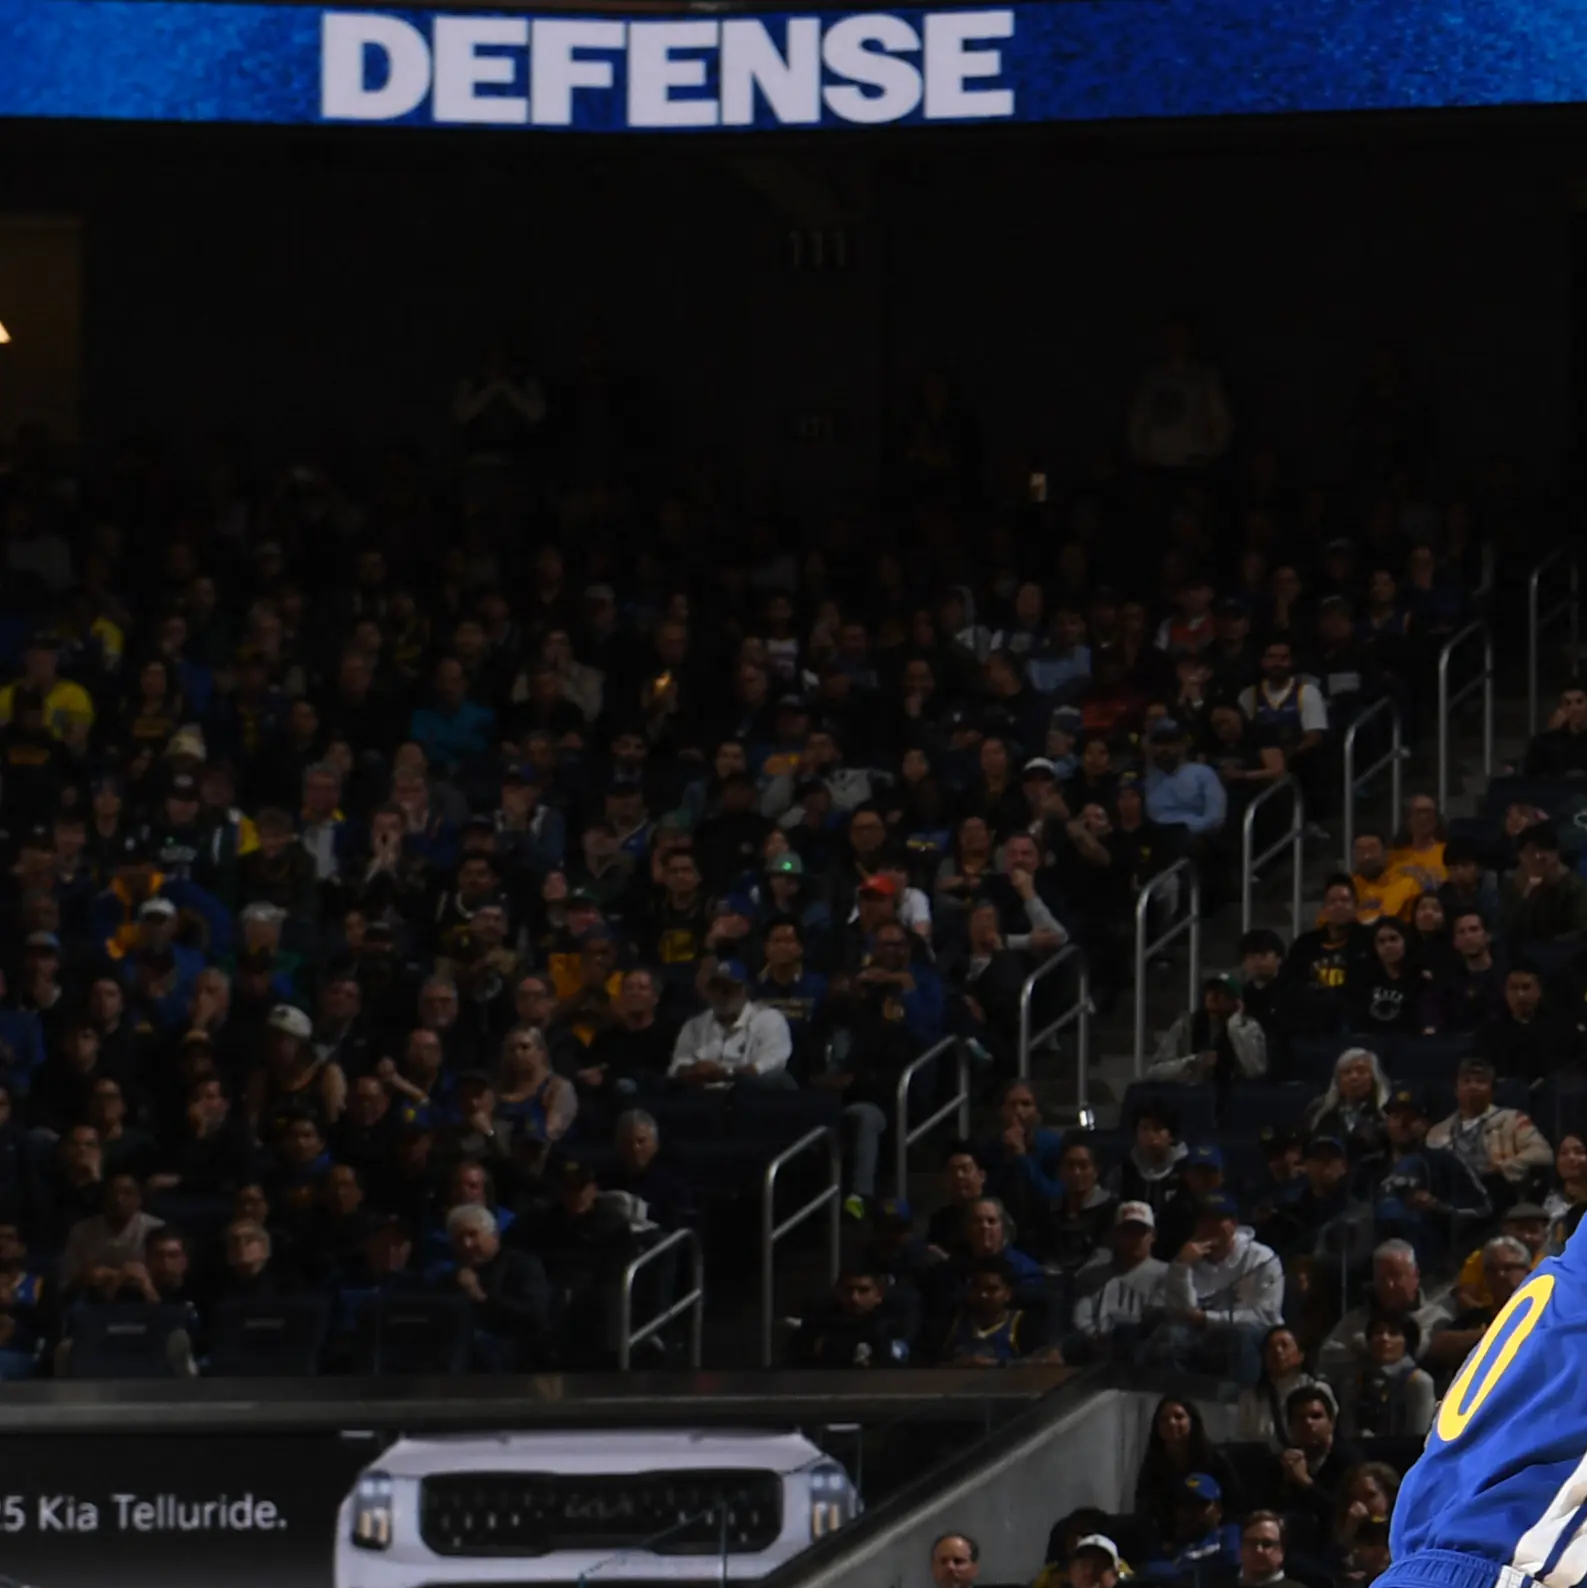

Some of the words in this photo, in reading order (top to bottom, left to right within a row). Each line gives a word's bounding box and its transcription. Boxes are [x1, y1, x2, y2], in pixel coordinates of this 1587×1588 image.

[320, 10, 1014, 127] DEFENSE
[785, 229, 848, 268] 111
[38, 1496, 98, 1531] Kia
[110, 1493, 288, 1532] Telluride.
